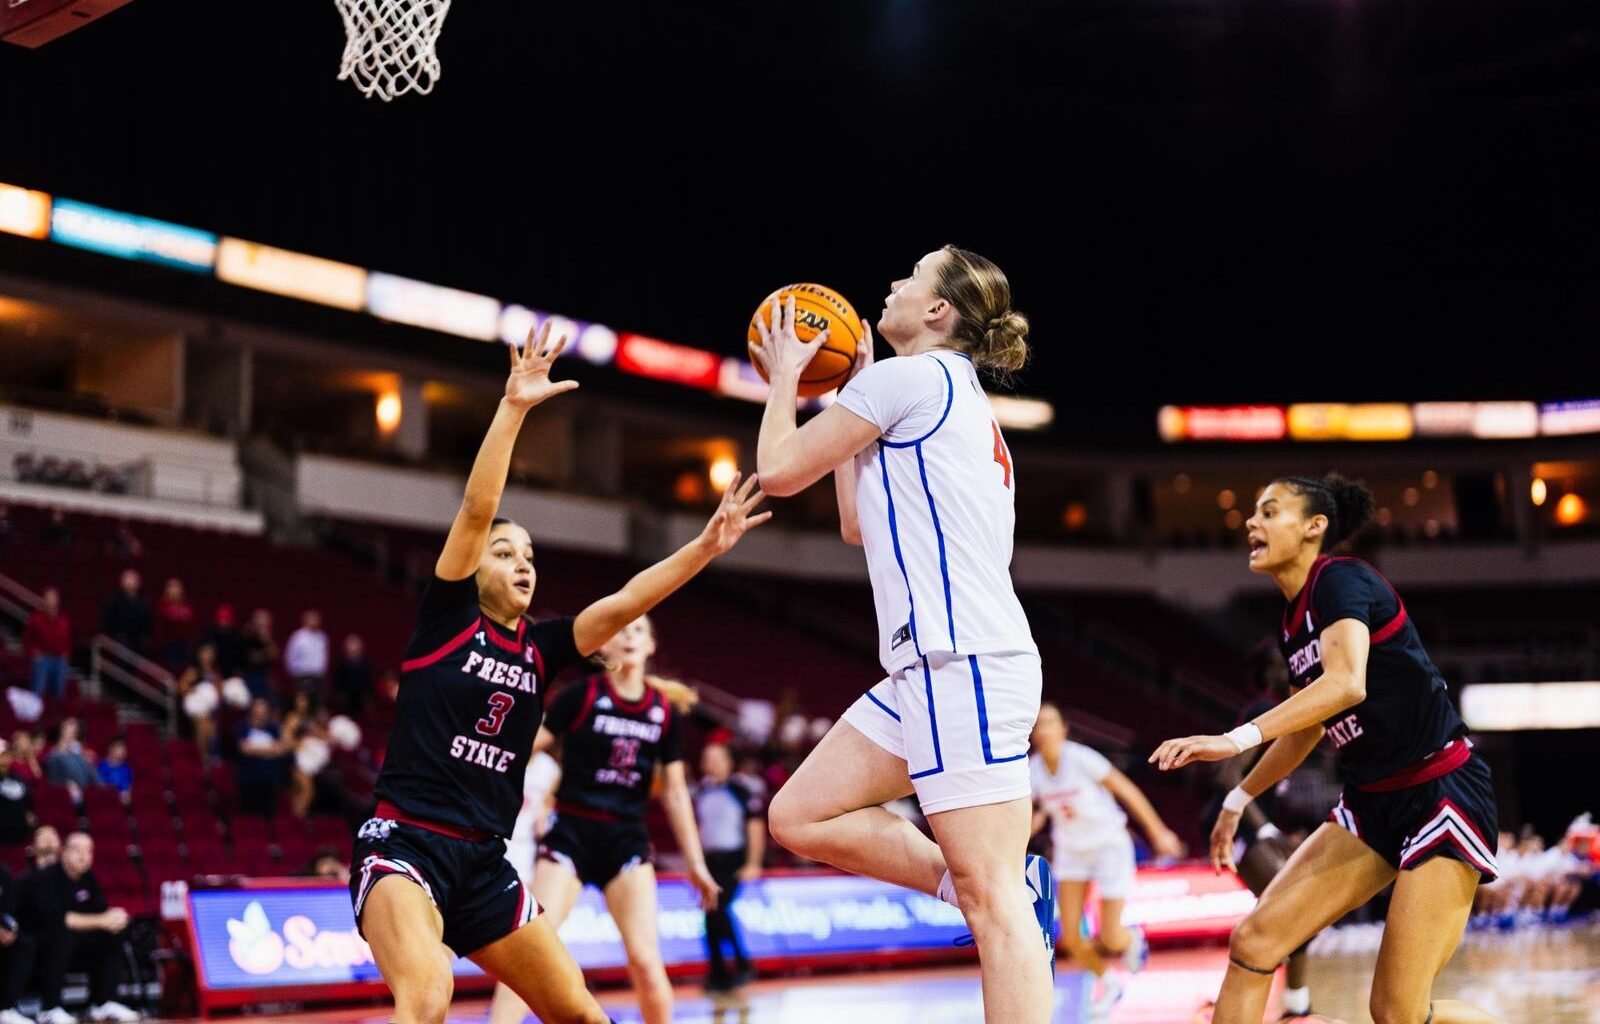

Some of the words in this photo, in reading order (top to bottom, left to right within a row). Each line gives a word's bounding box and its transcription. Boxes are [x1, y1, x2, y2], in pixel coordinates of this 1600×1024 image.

[781, 304, 829, 332] CAA
[990, 418, 1012, 490] 4
[474, 691, 516, 737] 3
[450, 735, 516, 773] STATE
